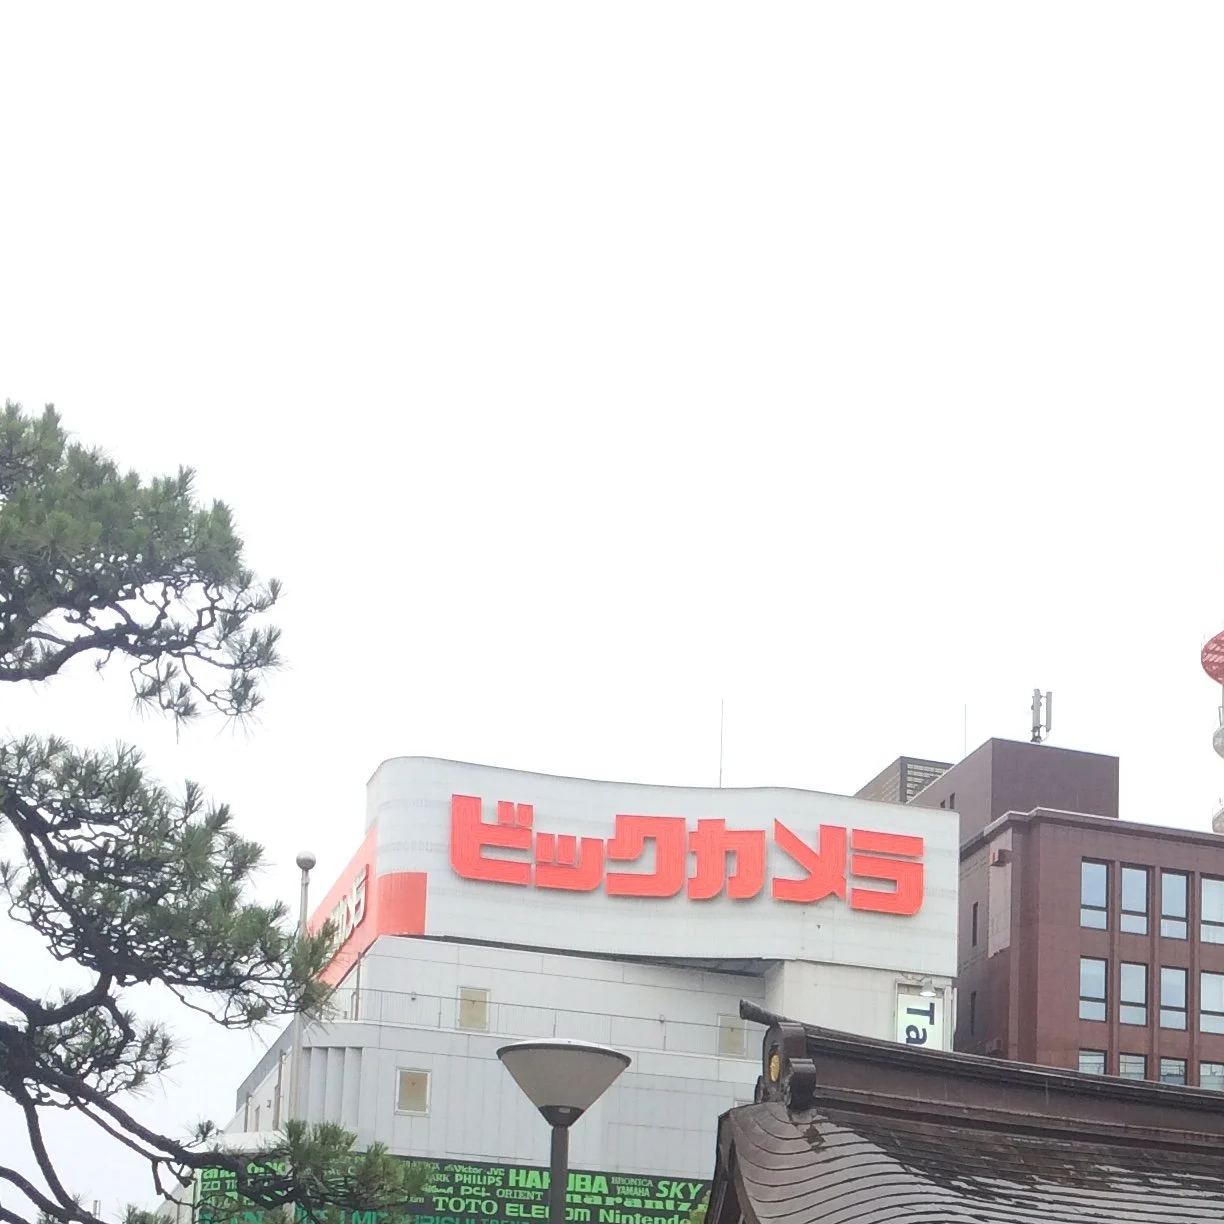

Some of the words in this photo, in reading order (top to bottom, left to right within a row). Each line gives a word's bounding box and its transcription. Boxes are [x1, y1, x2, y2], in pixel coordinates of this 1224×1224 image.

[450, 793, 924, 916] ビックカメラ
[487, 1168, 505, 1176] JVC
[454, 1173, 503, 1187] PHILIPS
[496, 1188, 544, 1200] ORIENT
[616, 1186, 650, 1197] YAMAHA
[655, 1180, 705, 1200] SKY
[432, 1196, 498, 1215] TOTO
